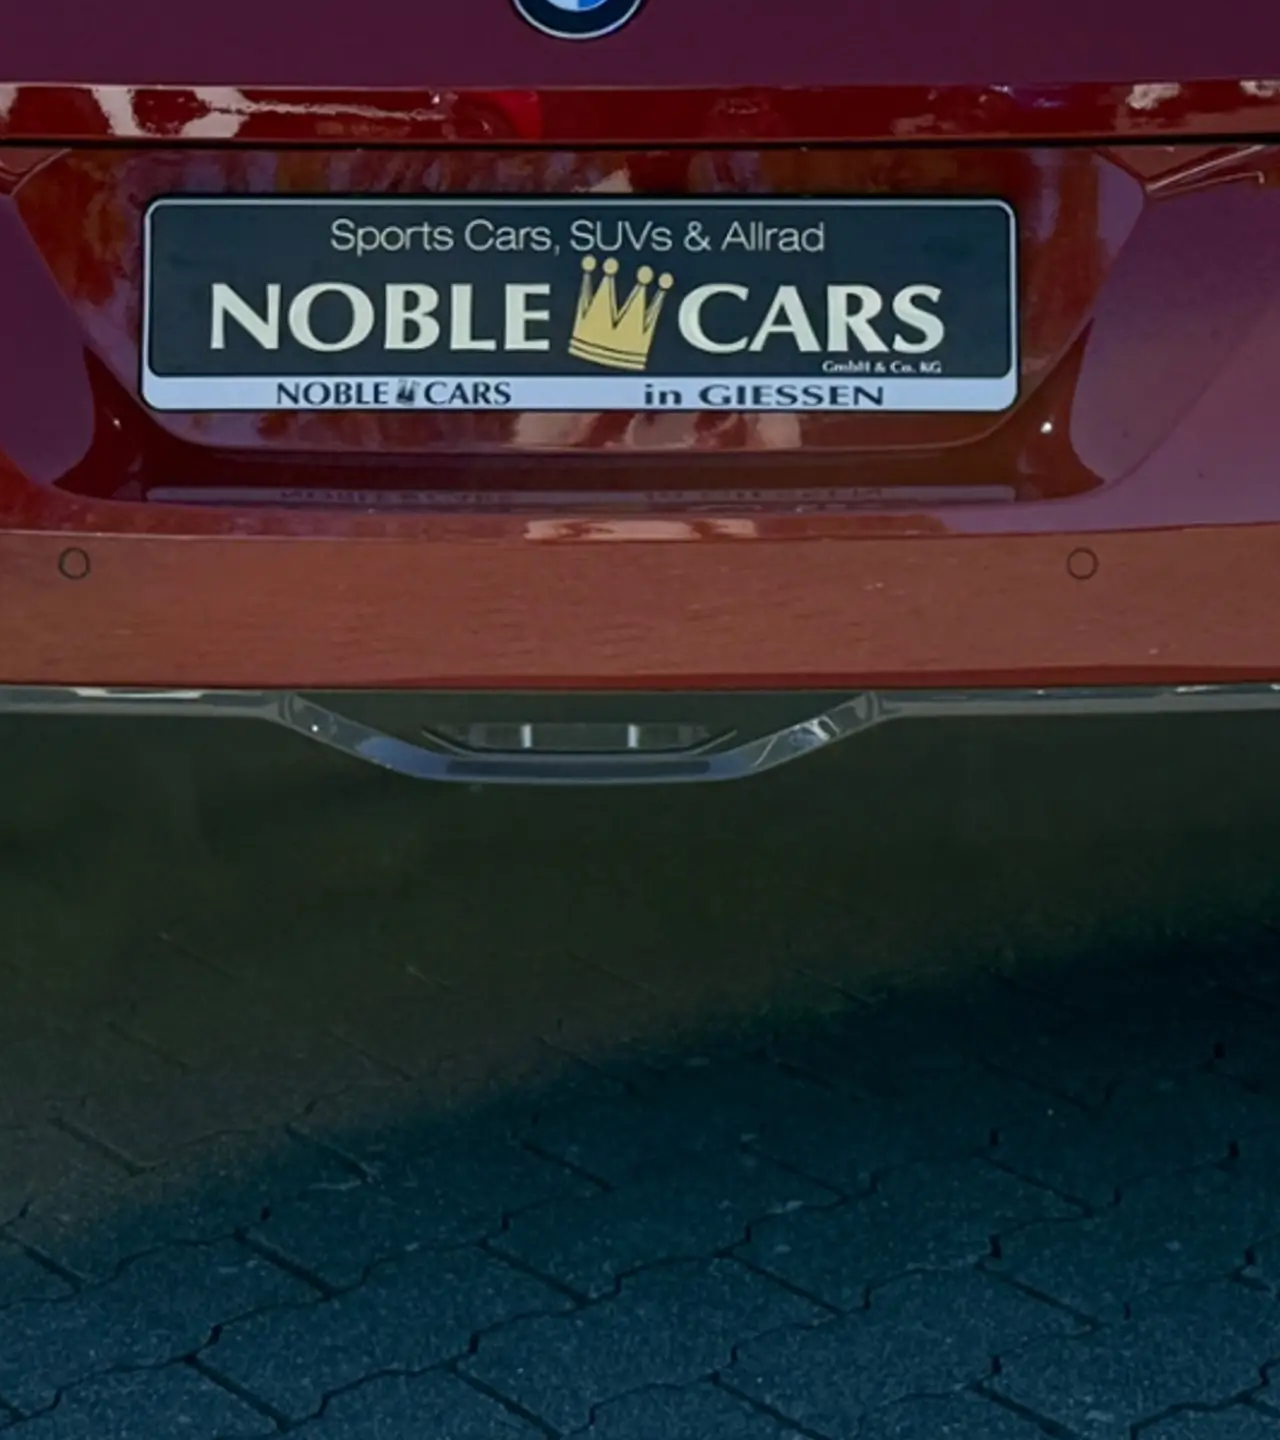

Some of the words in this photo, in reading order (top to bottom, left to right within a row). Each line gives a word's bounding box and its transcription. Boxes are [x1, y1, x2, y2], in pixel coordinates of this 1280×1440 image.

[330, 218, 455, 257] Sports
[464, 218, 560, 255] Cars,
[569, 220, 673, 251] SUVs
[683, 221, 711, 251] &
[721, 221, 825, 251] Allrad
[210, 282, 551, 352] NOBLE
[677, 283, 945, 354] CARS
[276, 381, 389, 406] NOBLE
[424, 382, 512, 406] CARS
[644, 383, 683, 406] in
[699, 384, 885, 407] GIESSEN
